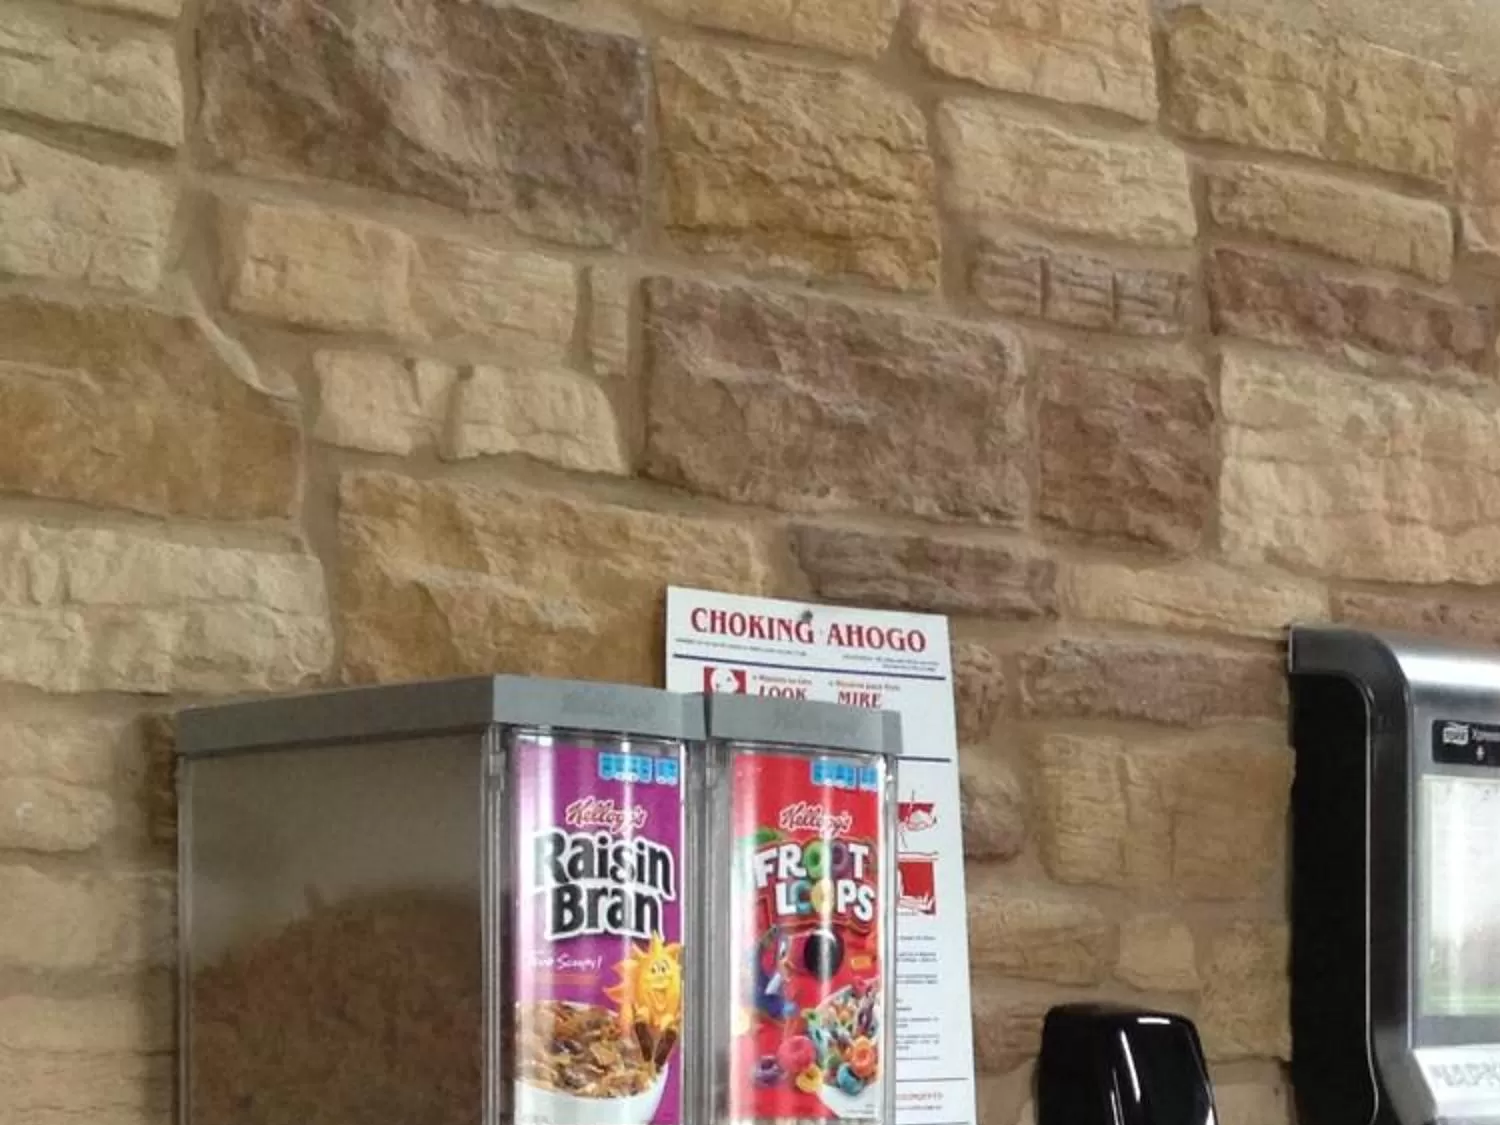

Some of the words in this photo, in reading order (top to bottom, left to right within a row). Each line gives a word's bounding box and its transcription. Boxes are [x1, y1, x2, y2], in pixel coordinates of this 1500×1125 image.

[690, 606, 815, 646] CHOKING
[827, 621, 928, 653] AHOGO
[565, 796, 648, 833] Kellogg's
[779, 801, 853, 836] Kellogg's
[532, 828, 674, 900] Raisin
[753, 840, 870, 888] FROOT
[549, 882, 664, 938] Bran
